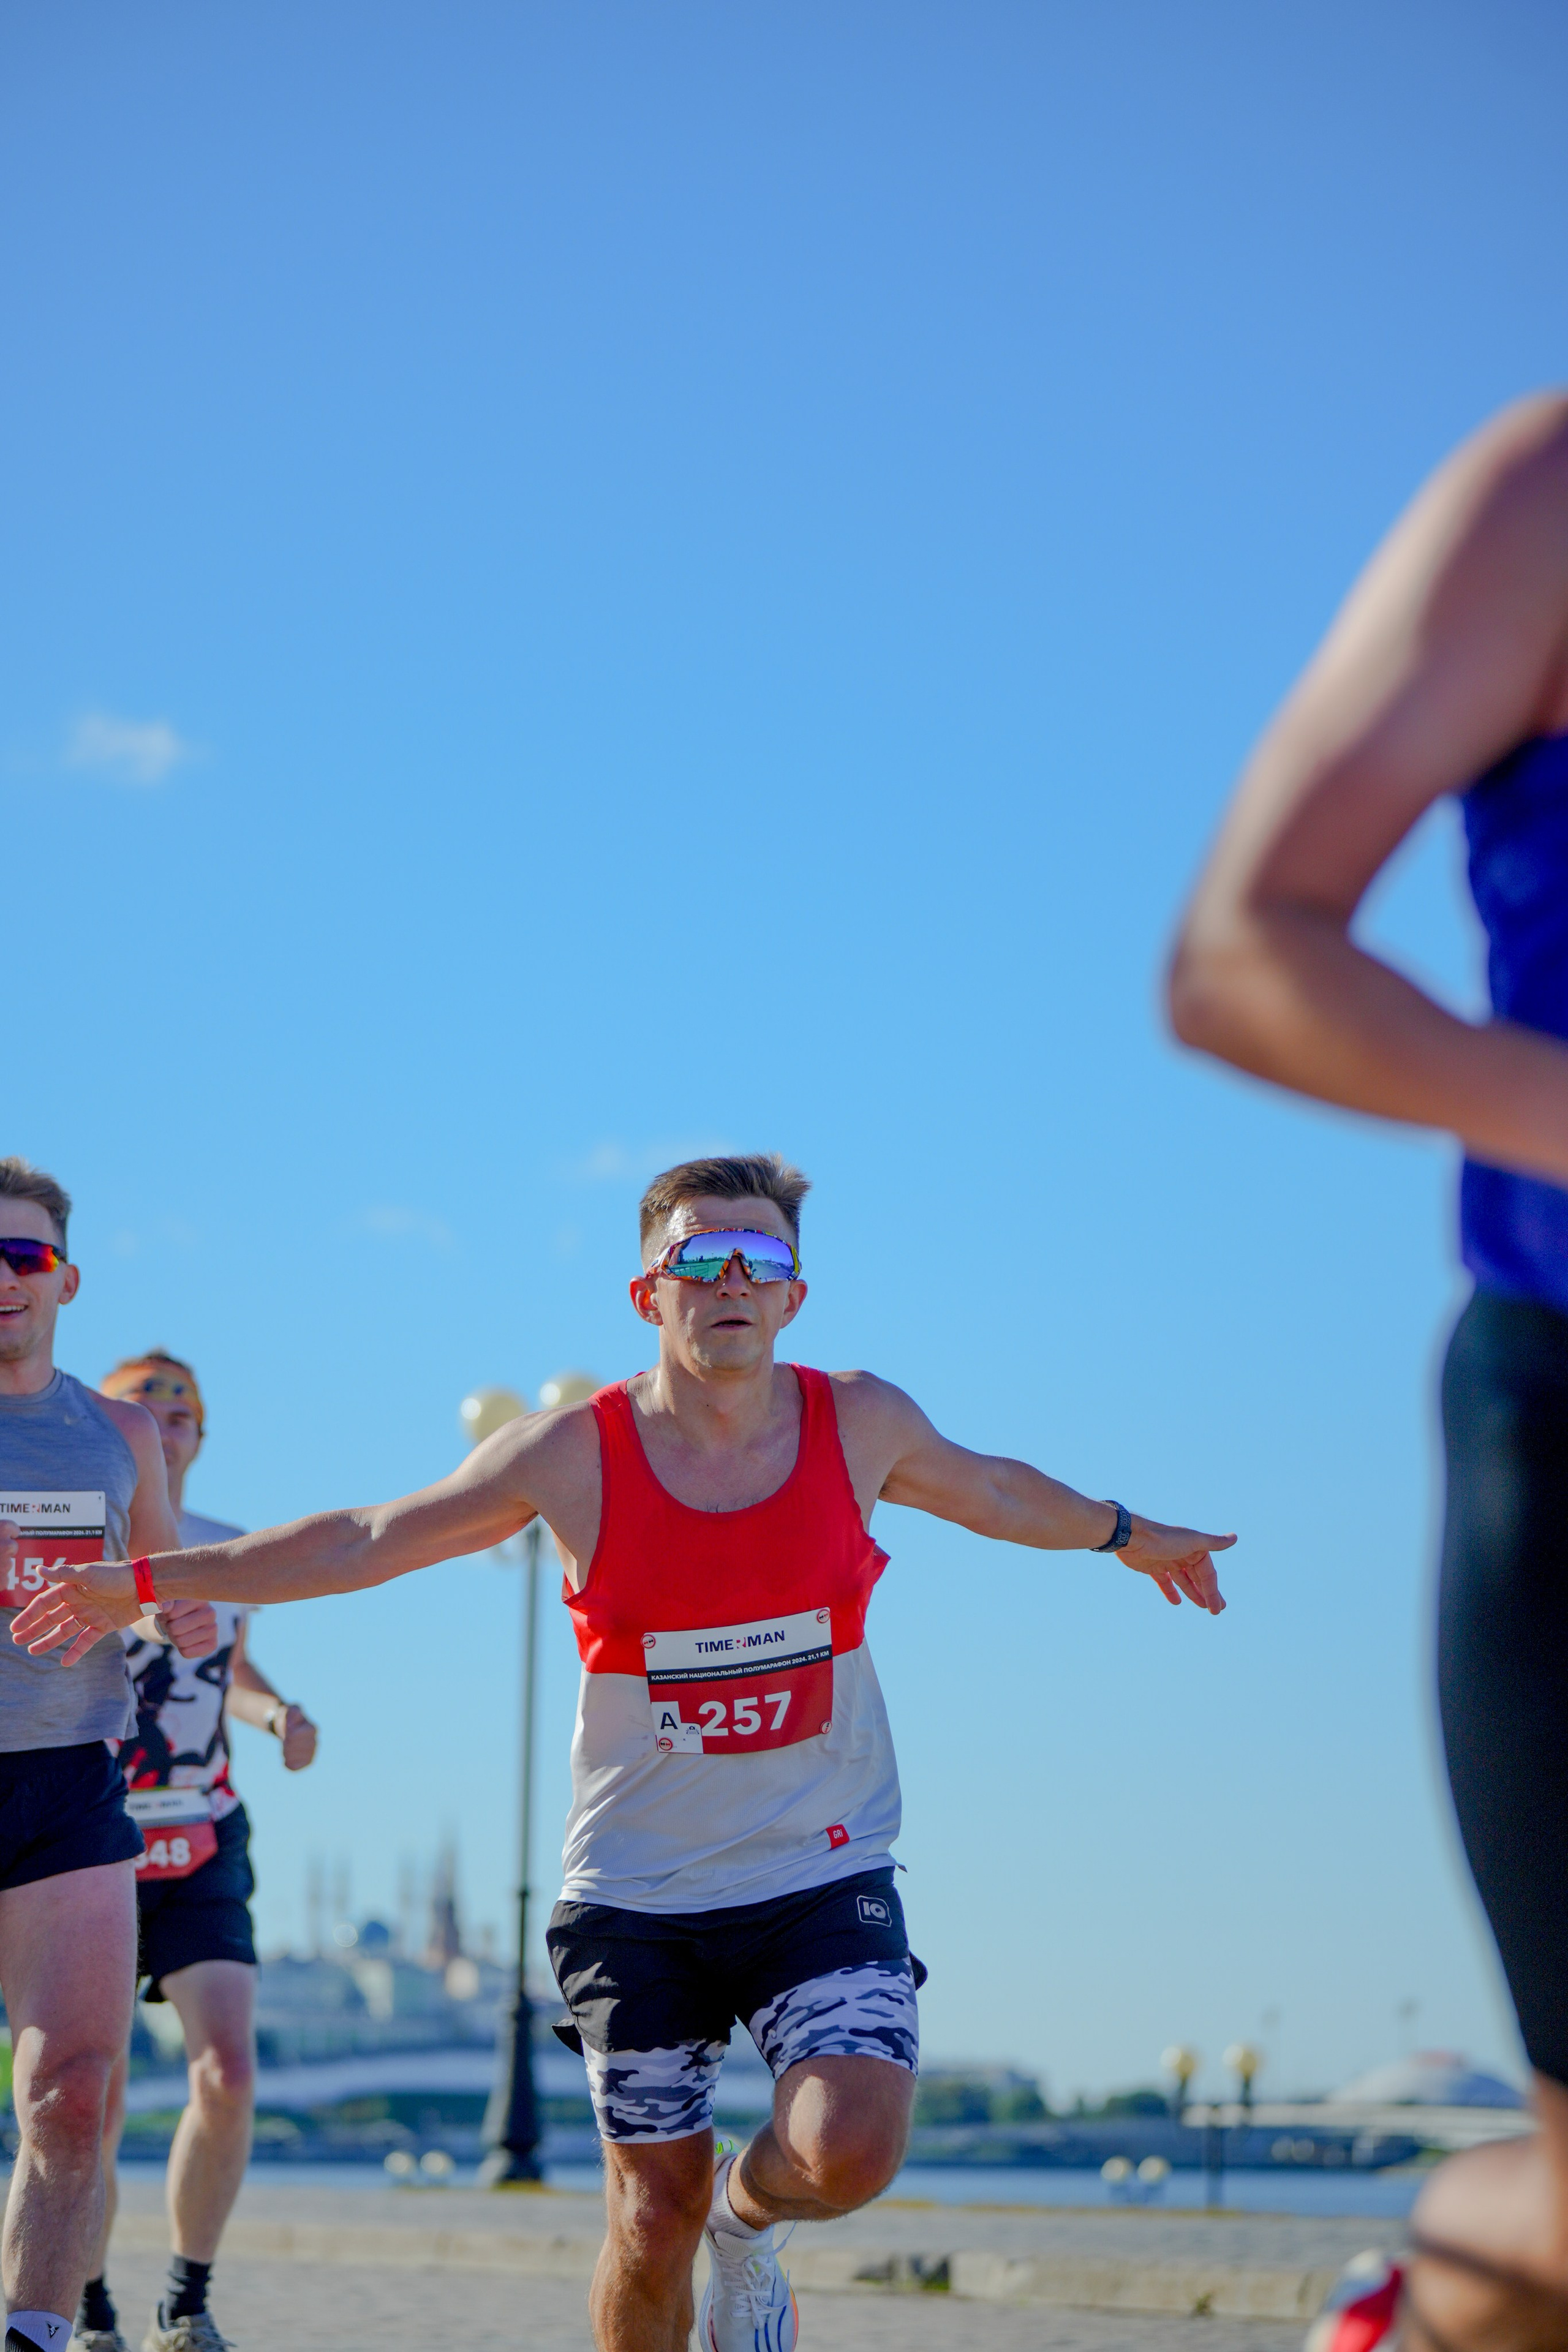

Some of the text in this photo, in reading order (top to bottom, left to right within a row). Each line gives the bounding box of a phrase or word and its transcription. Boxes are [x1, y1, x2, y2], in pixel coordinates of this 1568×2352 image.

[689, 1667, 742, 1679] НАЦИОНАЛЬНЫЙ
[744, 1659, 791, 1673] ПОЛУМАРАФОН
[698, 1691, 791, 1736] 257
